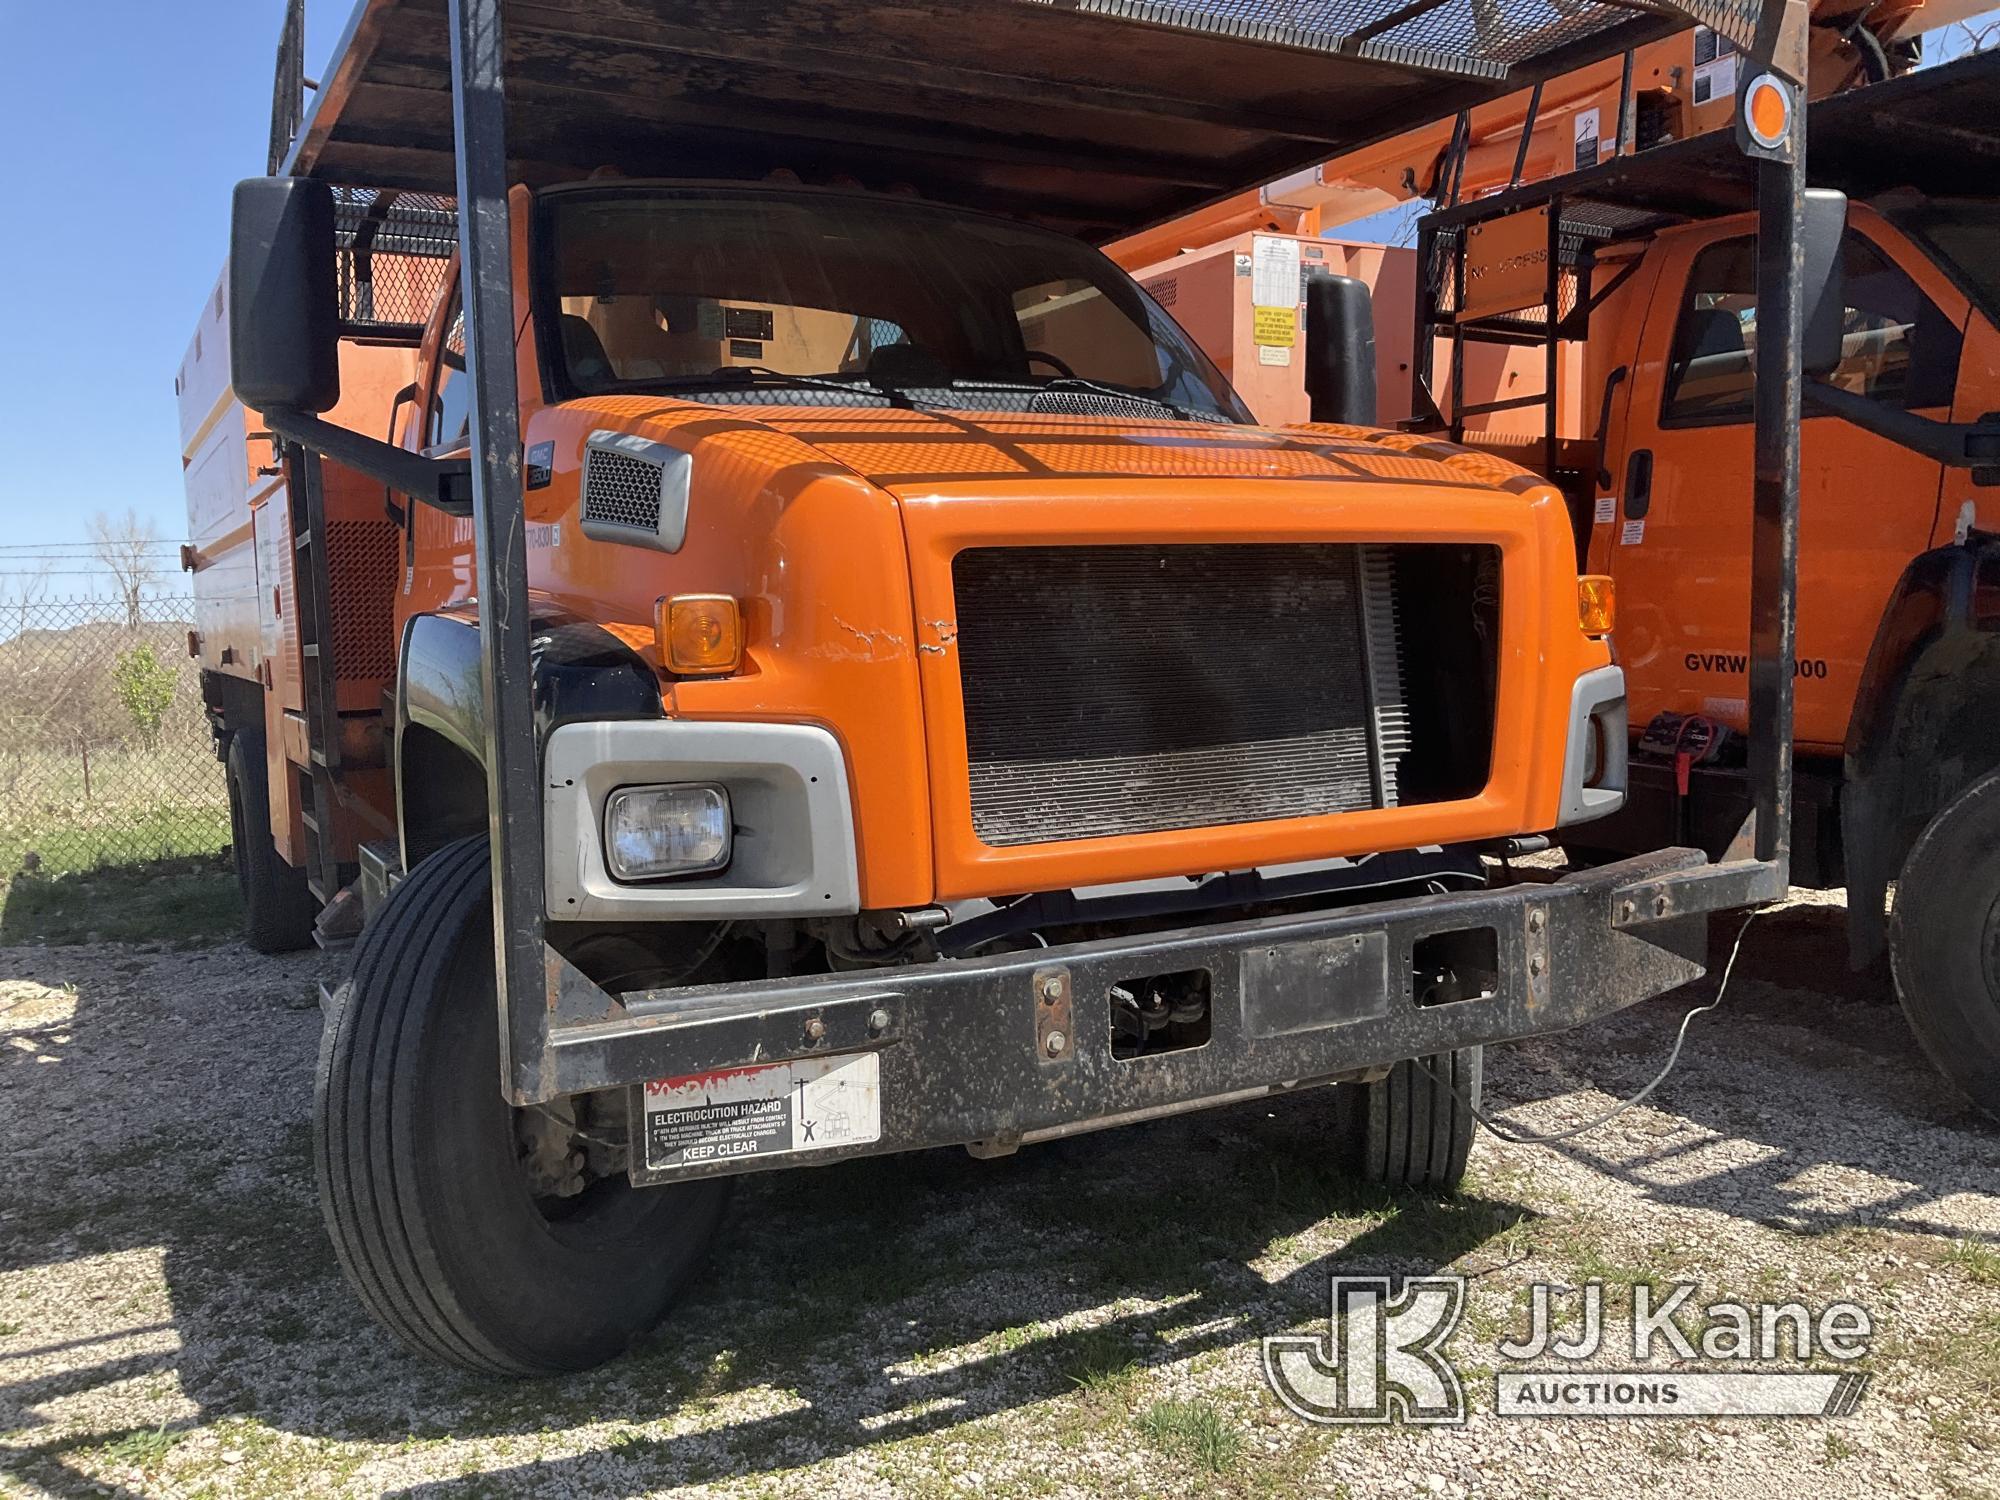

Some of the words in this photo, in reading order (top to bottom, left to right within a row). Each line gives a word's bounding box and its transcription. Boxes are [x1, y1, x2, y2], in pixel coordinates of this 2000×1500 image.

[1685, 653, 1747, 673] GVRW
[655, 1106, 738, 1126] ELECTROCUTION
[741, 1101, 781, 1116] HAZARD
[750, 1116, 764, 1124] FROM
[765, 1114, 786, 1122] CONTACT
[747, 1122, 780, 1131] ATTACHMENTS
[719, 1131, 752, 1141] ELECTRICALLY
[683, 1145, 714, 1160] KEEP
[717, 1140, 757, 1156] CLEAR
